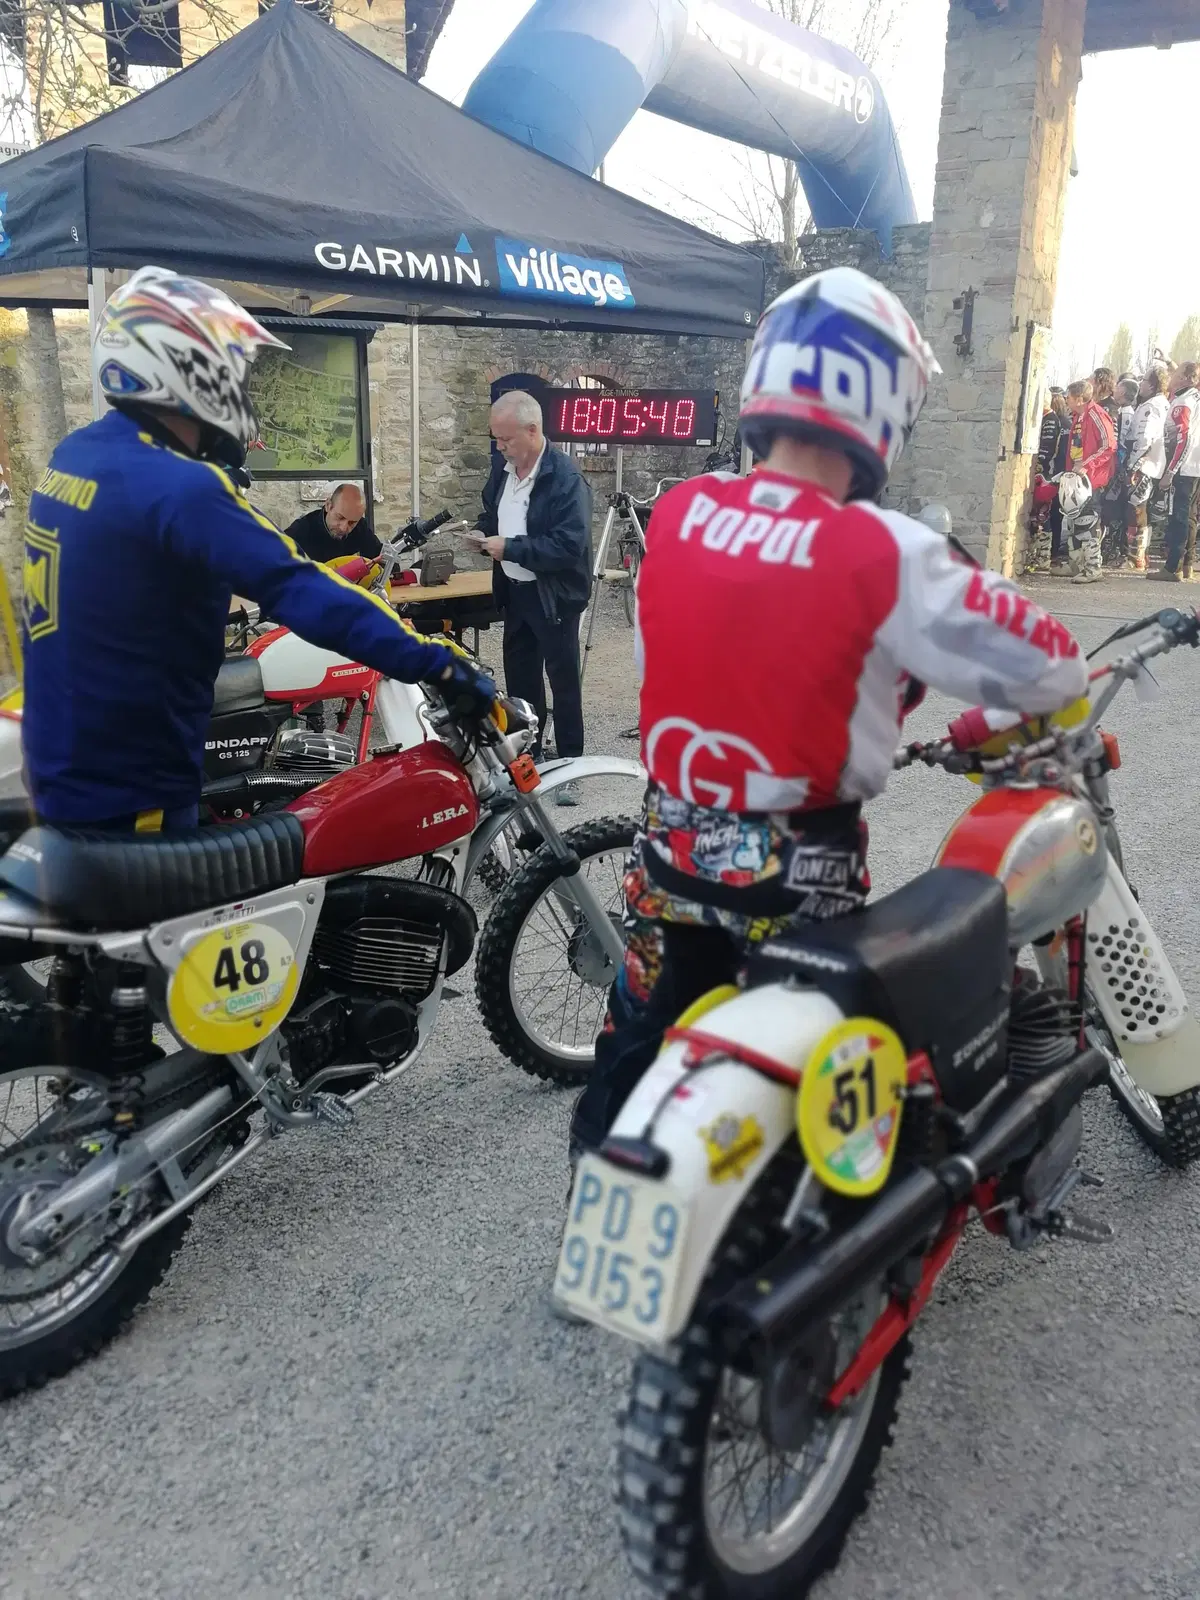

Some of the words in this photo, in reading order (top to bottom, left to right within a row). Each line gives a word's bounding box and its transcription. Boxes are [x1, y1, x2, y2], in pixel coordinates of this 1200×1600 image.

[314, 242, 481, 287] GARMIN
[505, 247, 627, 306] village
[560, 397, 695, 436] 18:05:48
[678, 491, 821, 569] POPOL
[219, 752, 231, 760] GS
[234, 750, 250, 758] 125
[214, 939, 269, 993] 48
[827, 1056, 877, 1136] 51
[573, 1171, 633, 1241] PD
[648, 1203, 679, 1260] 9
[559, 1234, 665, 1325] 9153
